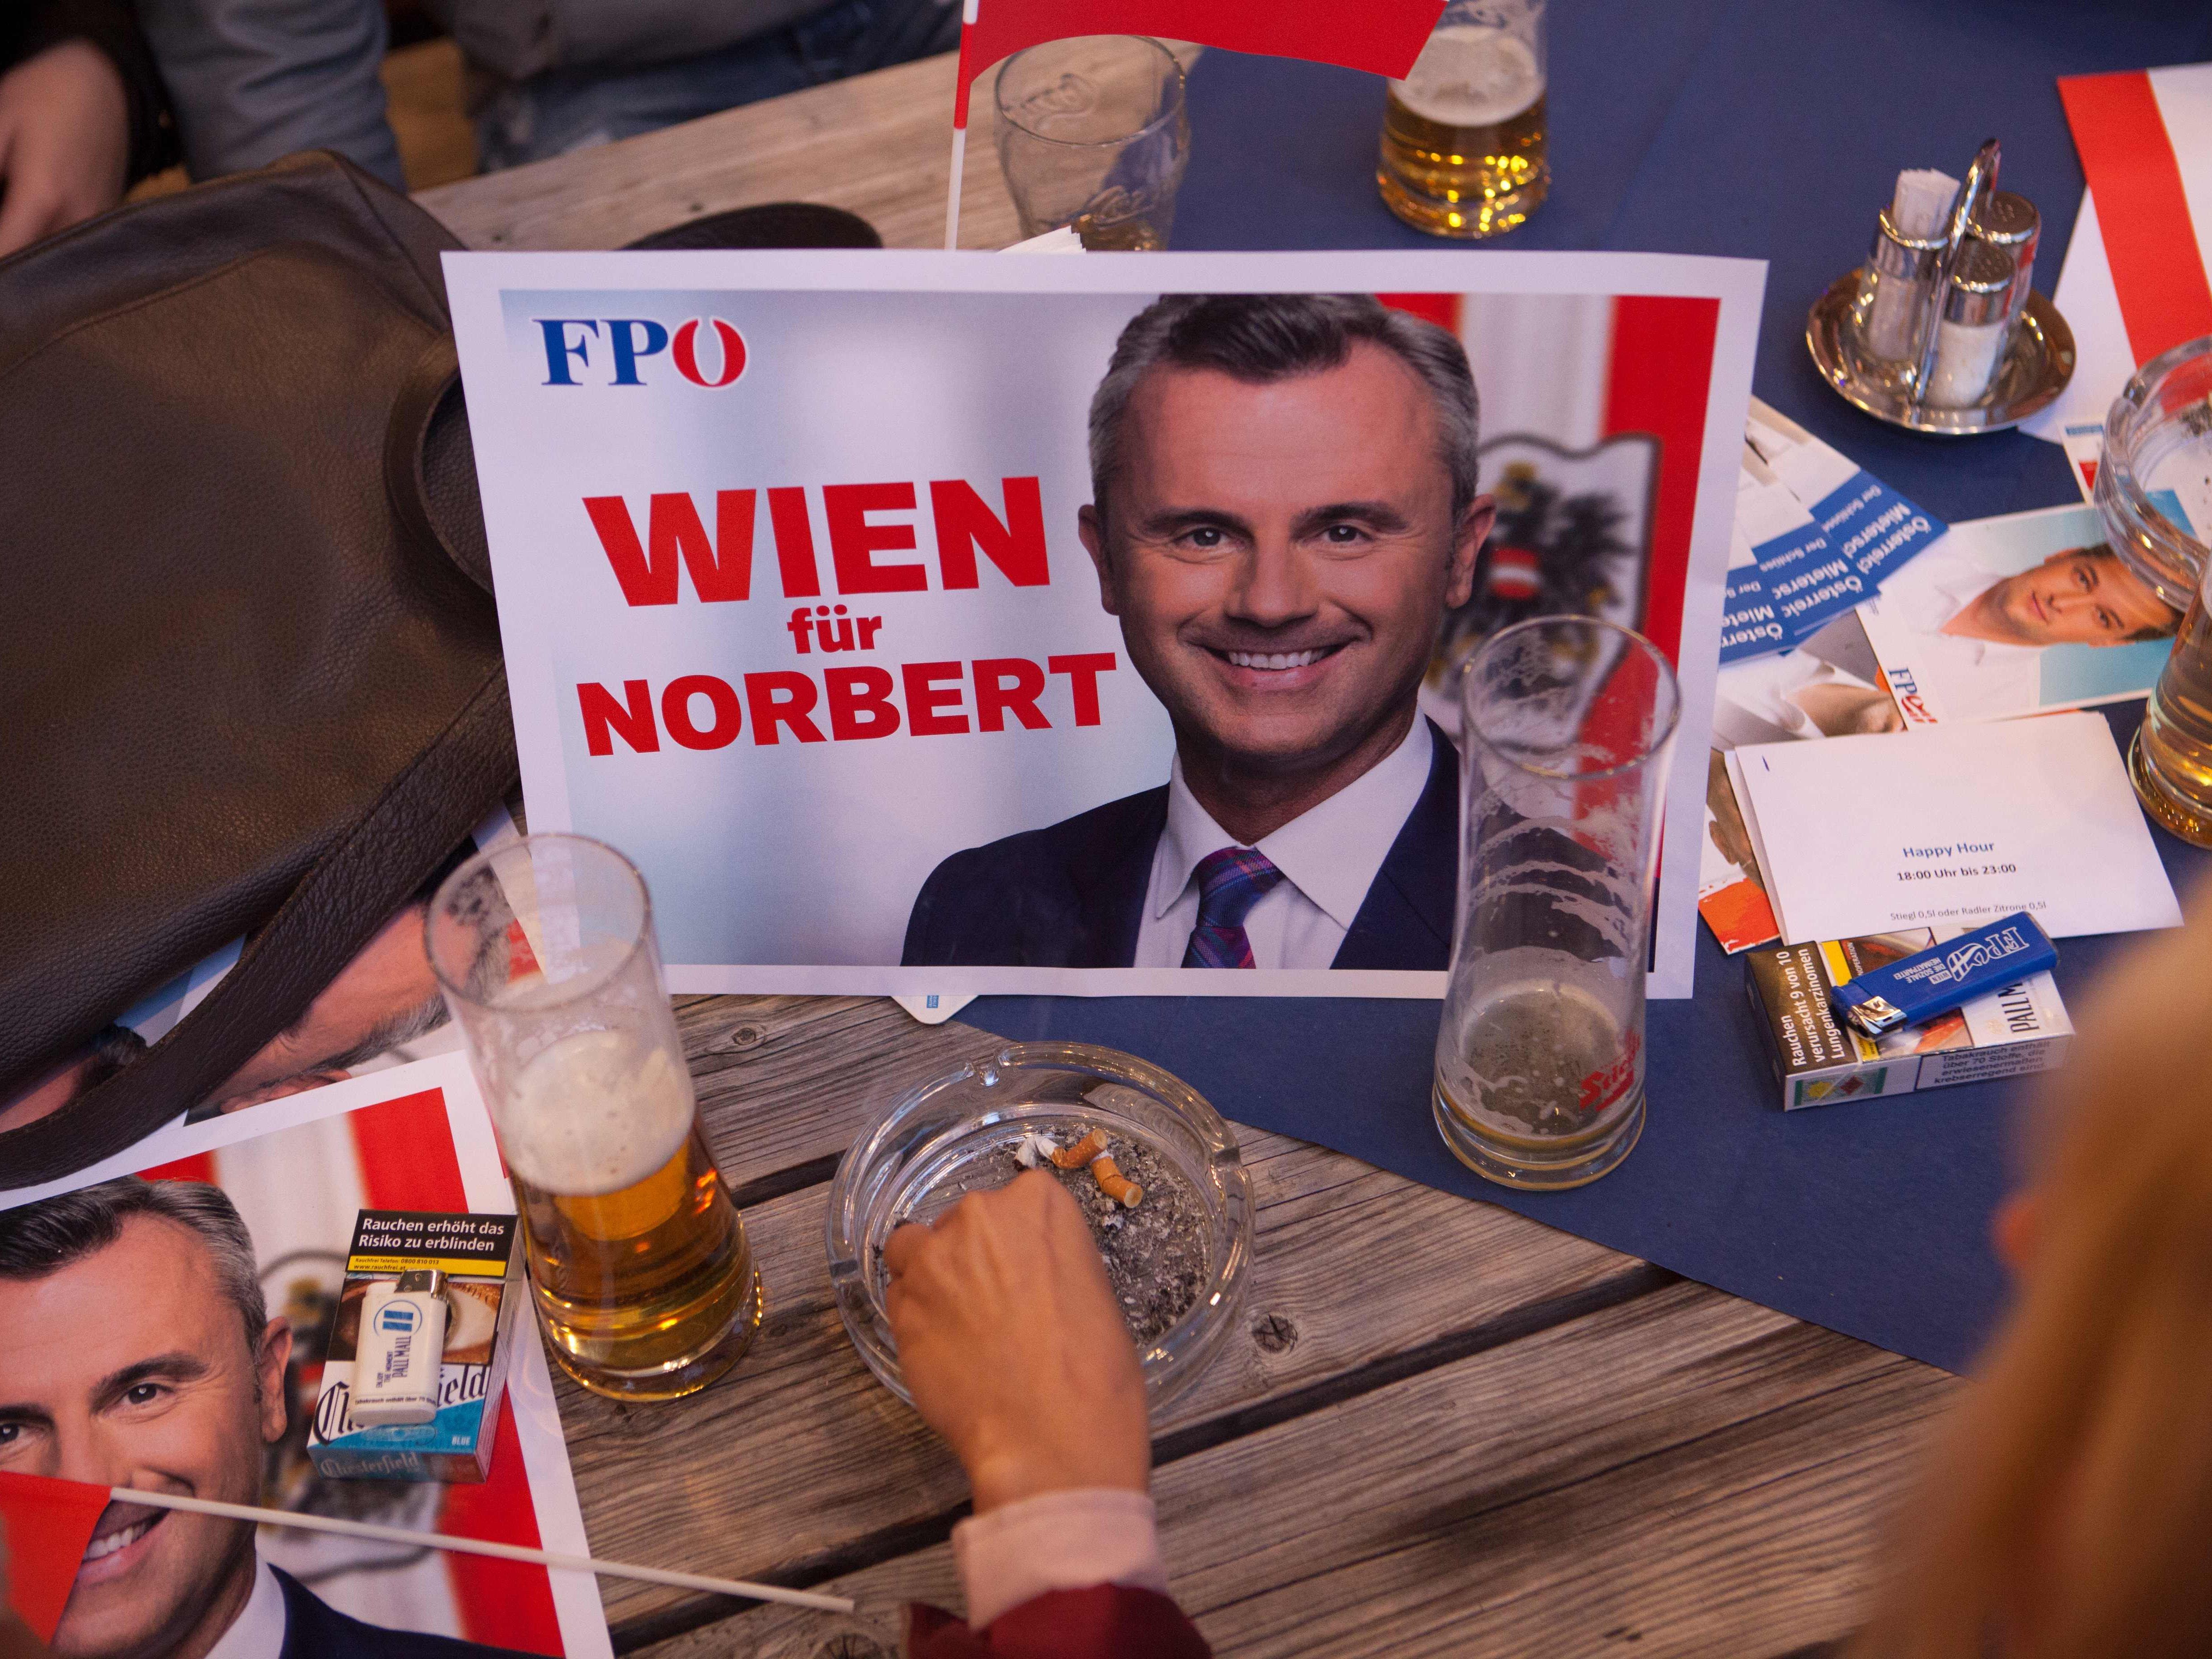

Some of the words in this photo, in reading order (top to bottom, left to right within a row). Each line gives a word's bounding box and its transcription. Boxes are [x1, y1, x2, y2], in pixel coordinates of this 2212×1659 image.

[582, 476, 1050, 607] WIEN
[1805, 538, 1827, 553] Der
[1738, 581, 1761, 595] Der
[787, 604, 882, 654] für
[576, 652, 1116, 756] NORBERT
[1902, 846, 1952, 859] Happy
[1957, 842, 1995, 854] Hour
[1897, 870, 1931, 881] 18:00
[1935, 868, 1957, 878] Uhr
[1961, 867, 1979, 877] bis
[1981, 864, 2017, 875] 23:00
[1890, 912, 1916, 921] Stiegl
[1918, 909, 1936, 919] 0,5l
[1938, 908, 1959, 917] oder
[1962, 905, 1991, 915] Radler
[1994, 903, 2027, 913] Zitrone
[2029, 900, 2047, 912] 0,5l
[1776, 951, 1792, 966] 10
[1893, 957, 1942, 980] HEIMATPARTEI
[1935, 963, 1946, 974] DIE
[1785, 967, 1800, 989] von
[1906, 969, 1934, 983] SOZIALE
[1930, 970, 1950, 984] WIEN
[1790, 990, 1804, 999] 9
[1798, 948, 1845, 1059] Lungenkarzinomen
[2001, 997, 2040, 1034] PALL
[1781, 1014, 1807, 1066] Rauchen
[1794, 1000, 1826, 1062] verursacht
[1943, 1047, 2008, 1062] Tabakrauch
[1943, 1060, 1968, 1069] über
[2028, 1049, 2046, 1057] die
[1934, 1066, 2016, 1084] krebserregend
[2020, 1062, 2045, 1071] sind
[363, 1218, 424, 1232] Rauchen
[427, 1220, 476, 1233] erhöht
[479, 1222, 505, 1235] das
[359, 1234, 401, 1248] Risiko
[404, 1238, 421, 1248] zu
[425, 1236, 495, 1251] erblinden
[394, 1336, 412, 1357] MALL
[392, 1358, 409, 1378] PALL
[452, 1436, 471, 1446] BLUE
